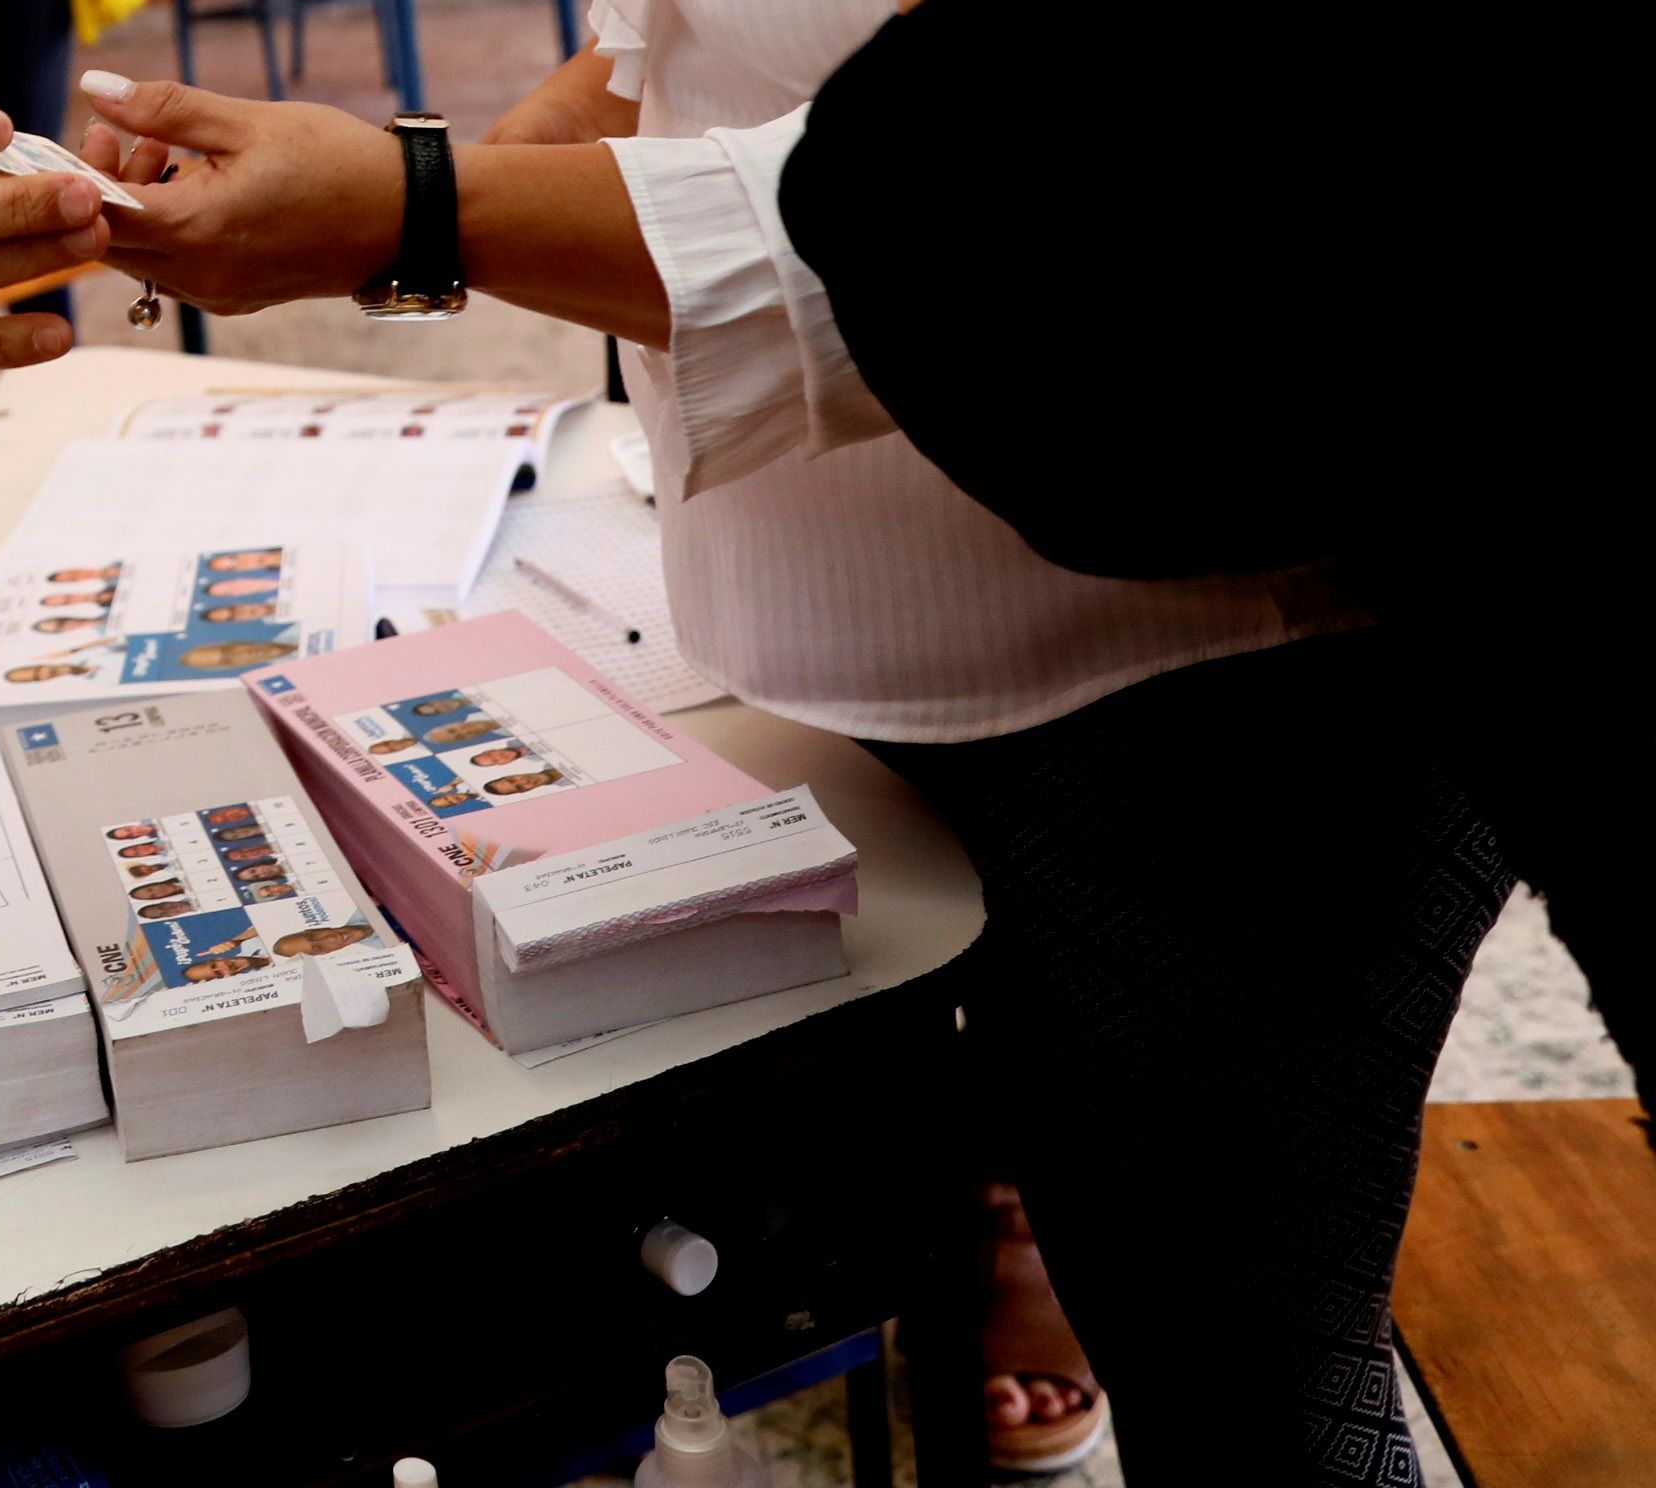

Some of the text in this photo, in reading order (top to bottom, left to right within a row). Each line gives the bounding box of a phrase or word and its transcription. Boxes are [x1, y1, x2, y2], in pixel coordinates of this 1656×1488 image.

[95, 712, 143, 733] 13
[784, 813, 806, 826] MER
[409, 817, 449, 838] 1301
[720, 827, 752, 841] 5515
[437, 843, 473, 867] CNE
[579, 859, 633, 880] PAPELETA
[523, 879, 549, 893] 043
[96, 943, 128, 973] CNE
[23, 974, 47, 984] MER
[375, 967, 402, 979] MER
[217, 992, 279, 1009] PAPELETA
[29, 1008, 54, 1017] MER
[162, 1006, 187, 1017] 001
